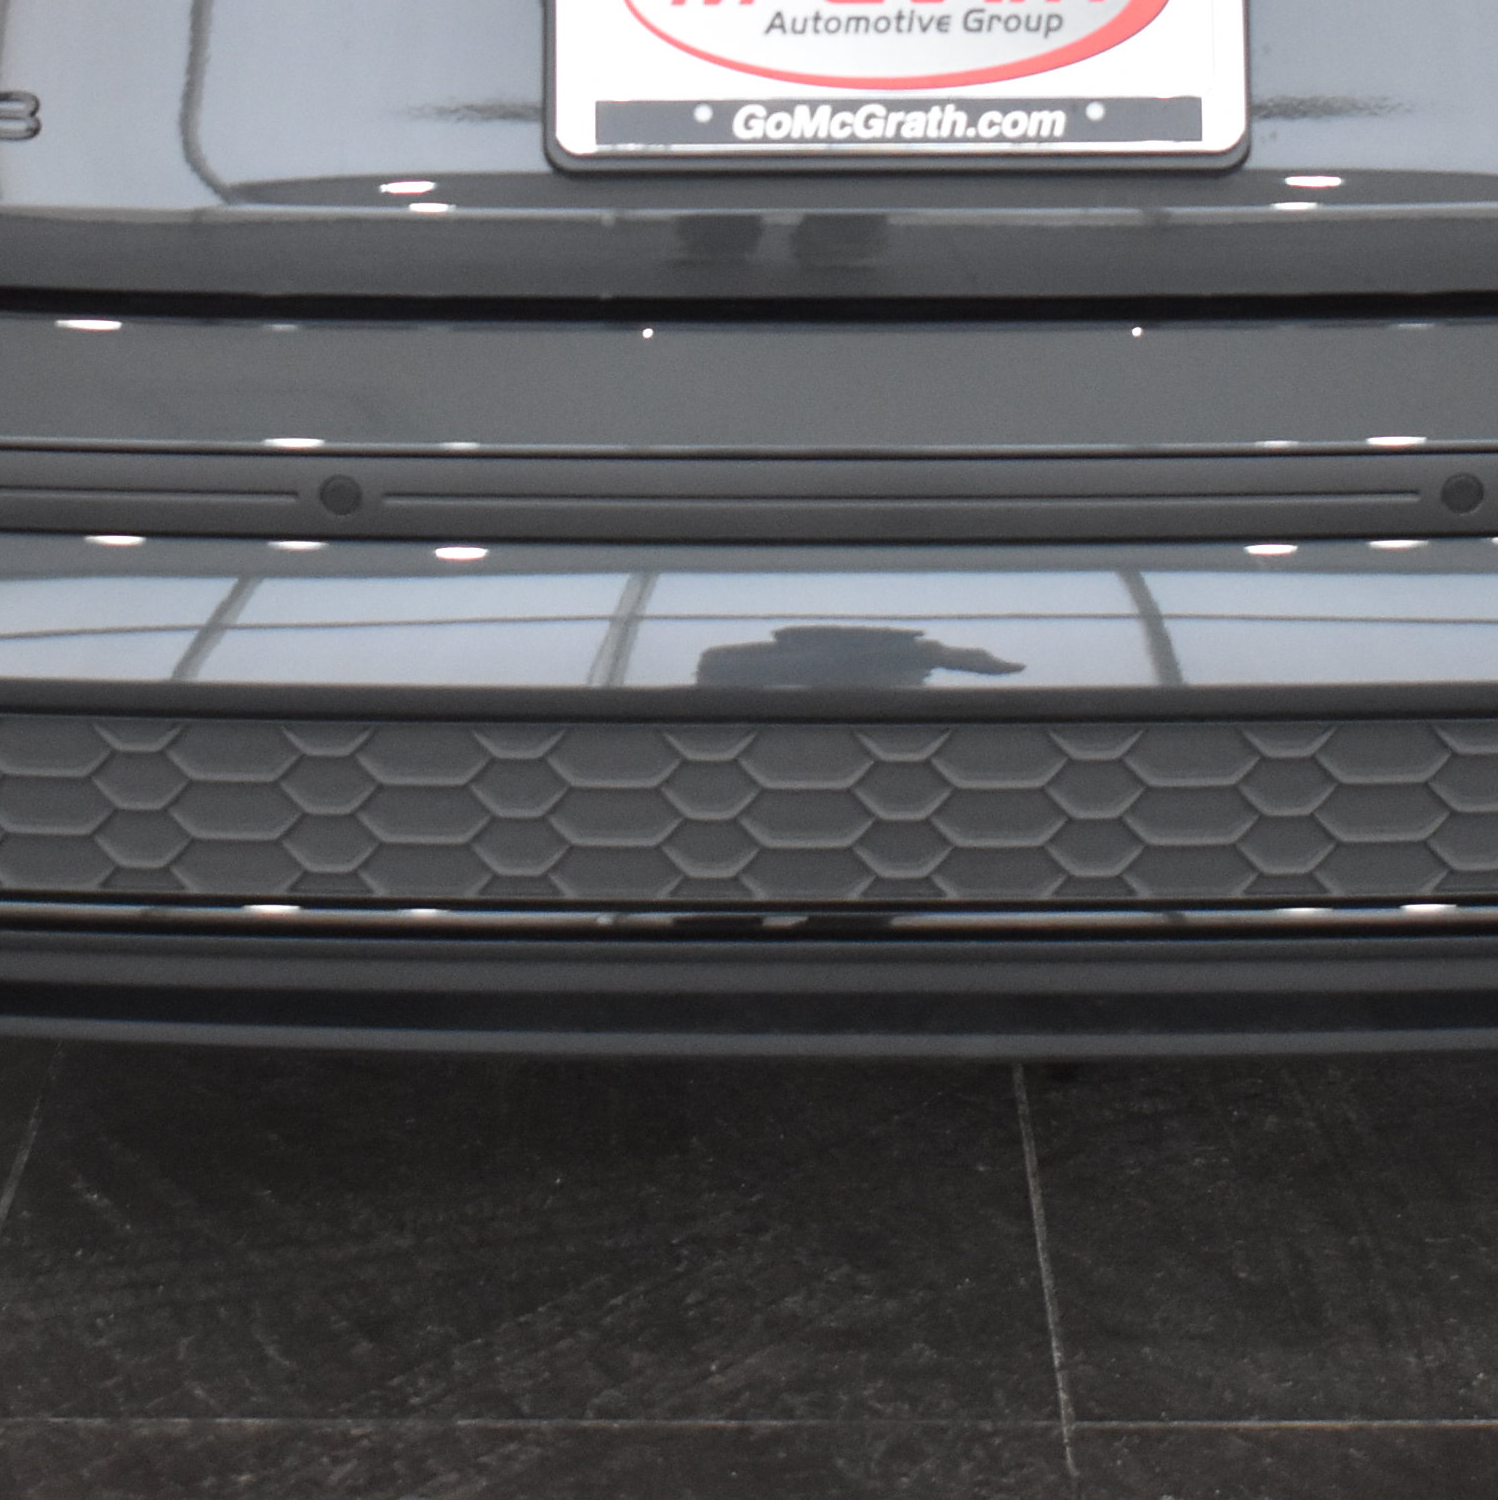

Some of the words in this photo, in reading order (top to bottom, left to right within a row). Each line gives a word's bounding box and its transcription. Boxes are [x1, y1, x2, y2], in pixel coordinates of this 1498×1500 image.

[764, 10, 952, 36] Automotive
[962, 8, 1063, 39] Group
[732, 103, 1067, 141] GoMcGrath.com
